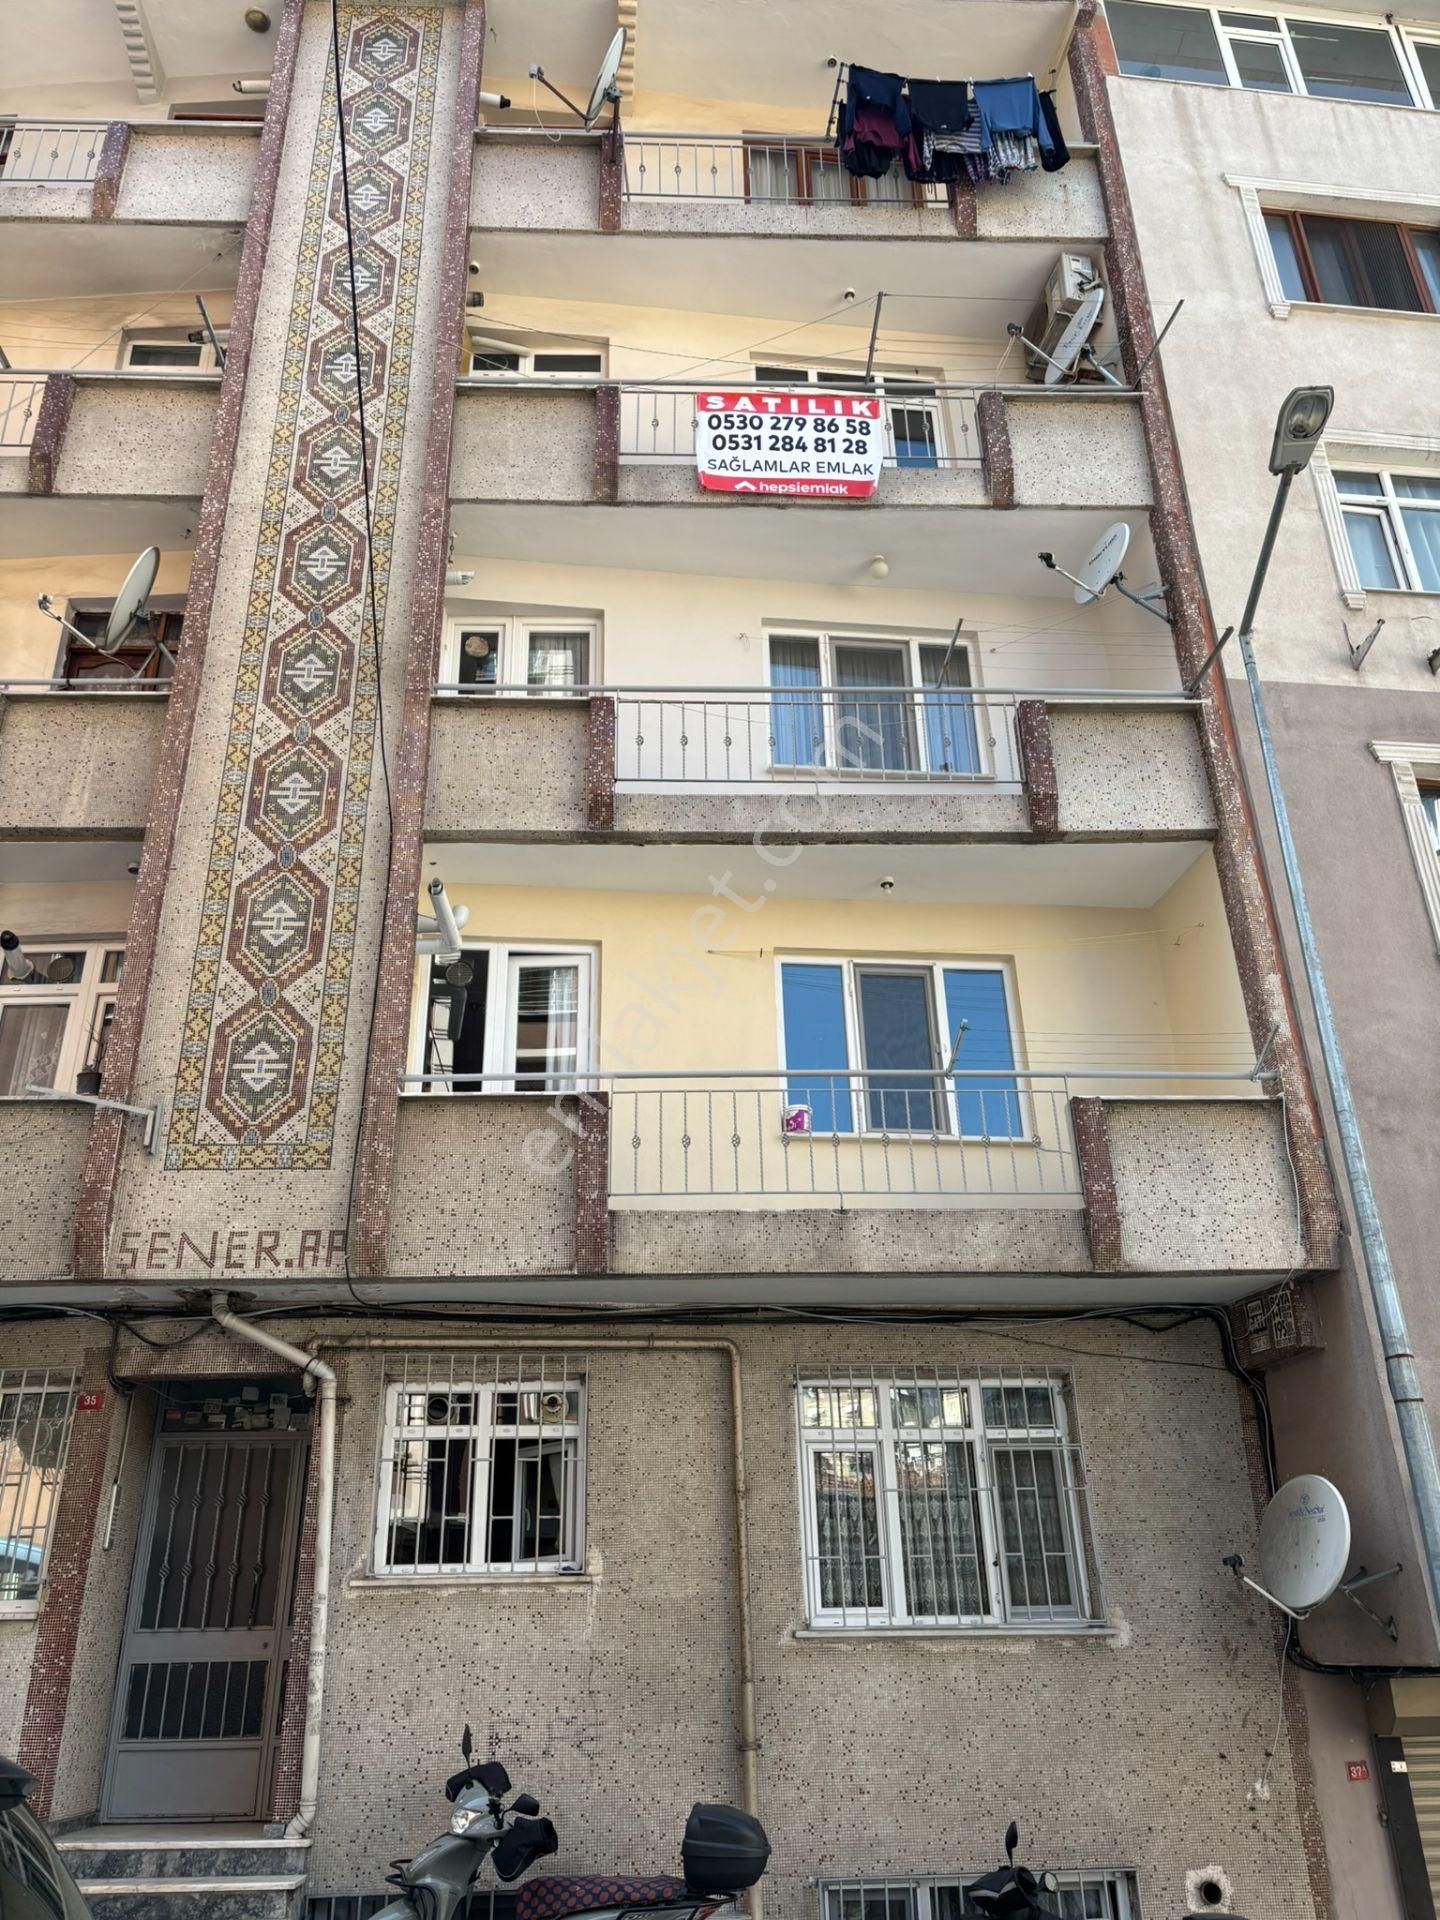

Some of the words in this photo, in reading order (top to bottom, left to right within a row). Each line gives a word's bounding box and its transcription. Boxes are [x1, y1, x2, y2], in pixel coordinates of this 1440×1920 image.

[706, 395, 873, 416] SATILIK
[708, 414, 764, 431] 0530
[770, 415, 807, 432] 279
[813, 417, 840, 434] 86
[846, 418, 872, 436] 58
[712, 434, 762, 451] 0531
[768, 436, 808, 453] 284
[814, 437, 836, 453] 81
[842, 438, 868, 455] 28
[707, 456, 811, 474] SAĞLAMLAR
[816, 461, 874, 476] EMLAK
[759, 481, 849, 495] hepsiemlak
[84, 1395, 97, 1405] 35
